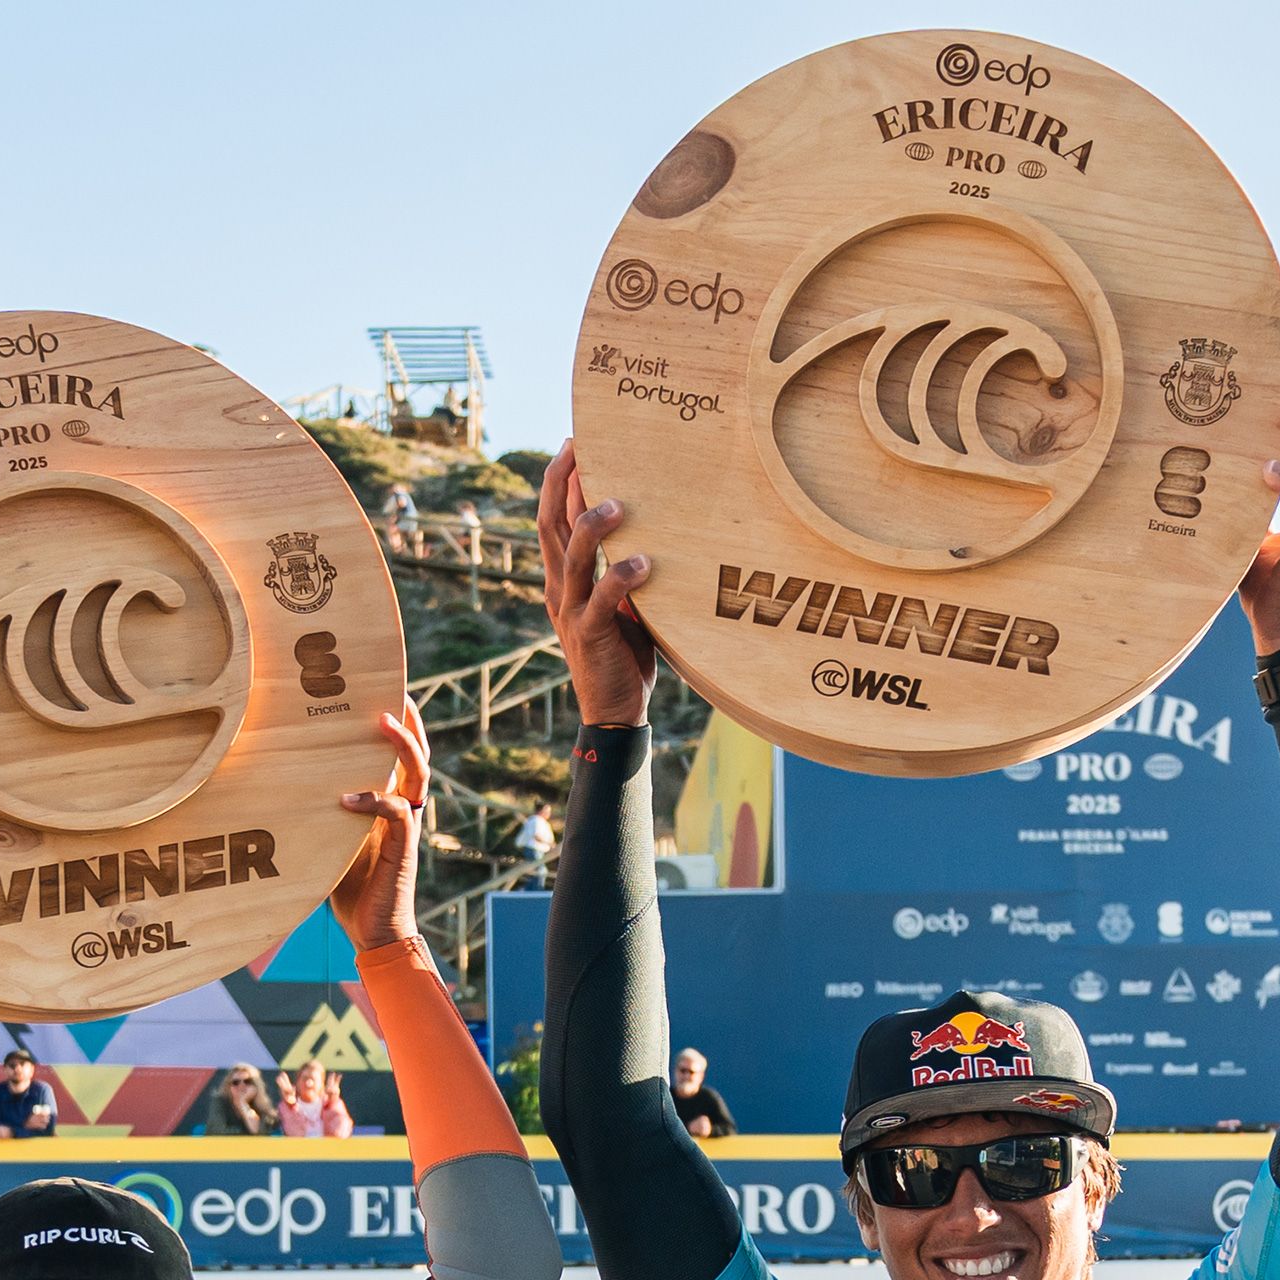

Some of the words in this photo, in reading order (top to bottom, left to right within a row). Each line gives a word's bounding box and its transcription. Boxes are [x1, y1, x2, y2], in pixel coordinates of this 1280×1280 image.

[984, 54, 1052, 96] edp
[872, 96, 1096, 176] ERICEIRA
[945, 146, 1007, 177] PRO
[949, 180, 991, 200] 2025
[663, 271, 745, 324] edp
[623, 354, 670, 380] visit
[616, 377, 725, 422] Portugal
[8, 455, 48, 473] 2025
[1147, 519, 1198, 538] Ericeira
[715, 564, 1060, 677] WINNER
[850, 666, 930, 711] WSL
[306, 701, 351, 718] Ericeira
[1055, 752, 1132, 782] PRO
[1066, 794, 1121, 815] 2025
[1018, 829, 1059, 842] PRAIA
[1063, 843, 1125, 855] ERICEIRA
[923, 907, 969, 937] edp
[107, 922, 187, 960] WSL
[912, 1055, 971, 1087] Red
[974, 1056, 1034, 1079] Bull
[190, 1167, 326, 1254] edp
[23, 1228, 62, 1249] RIP
[63, 1227, 127, 1245] CURL
